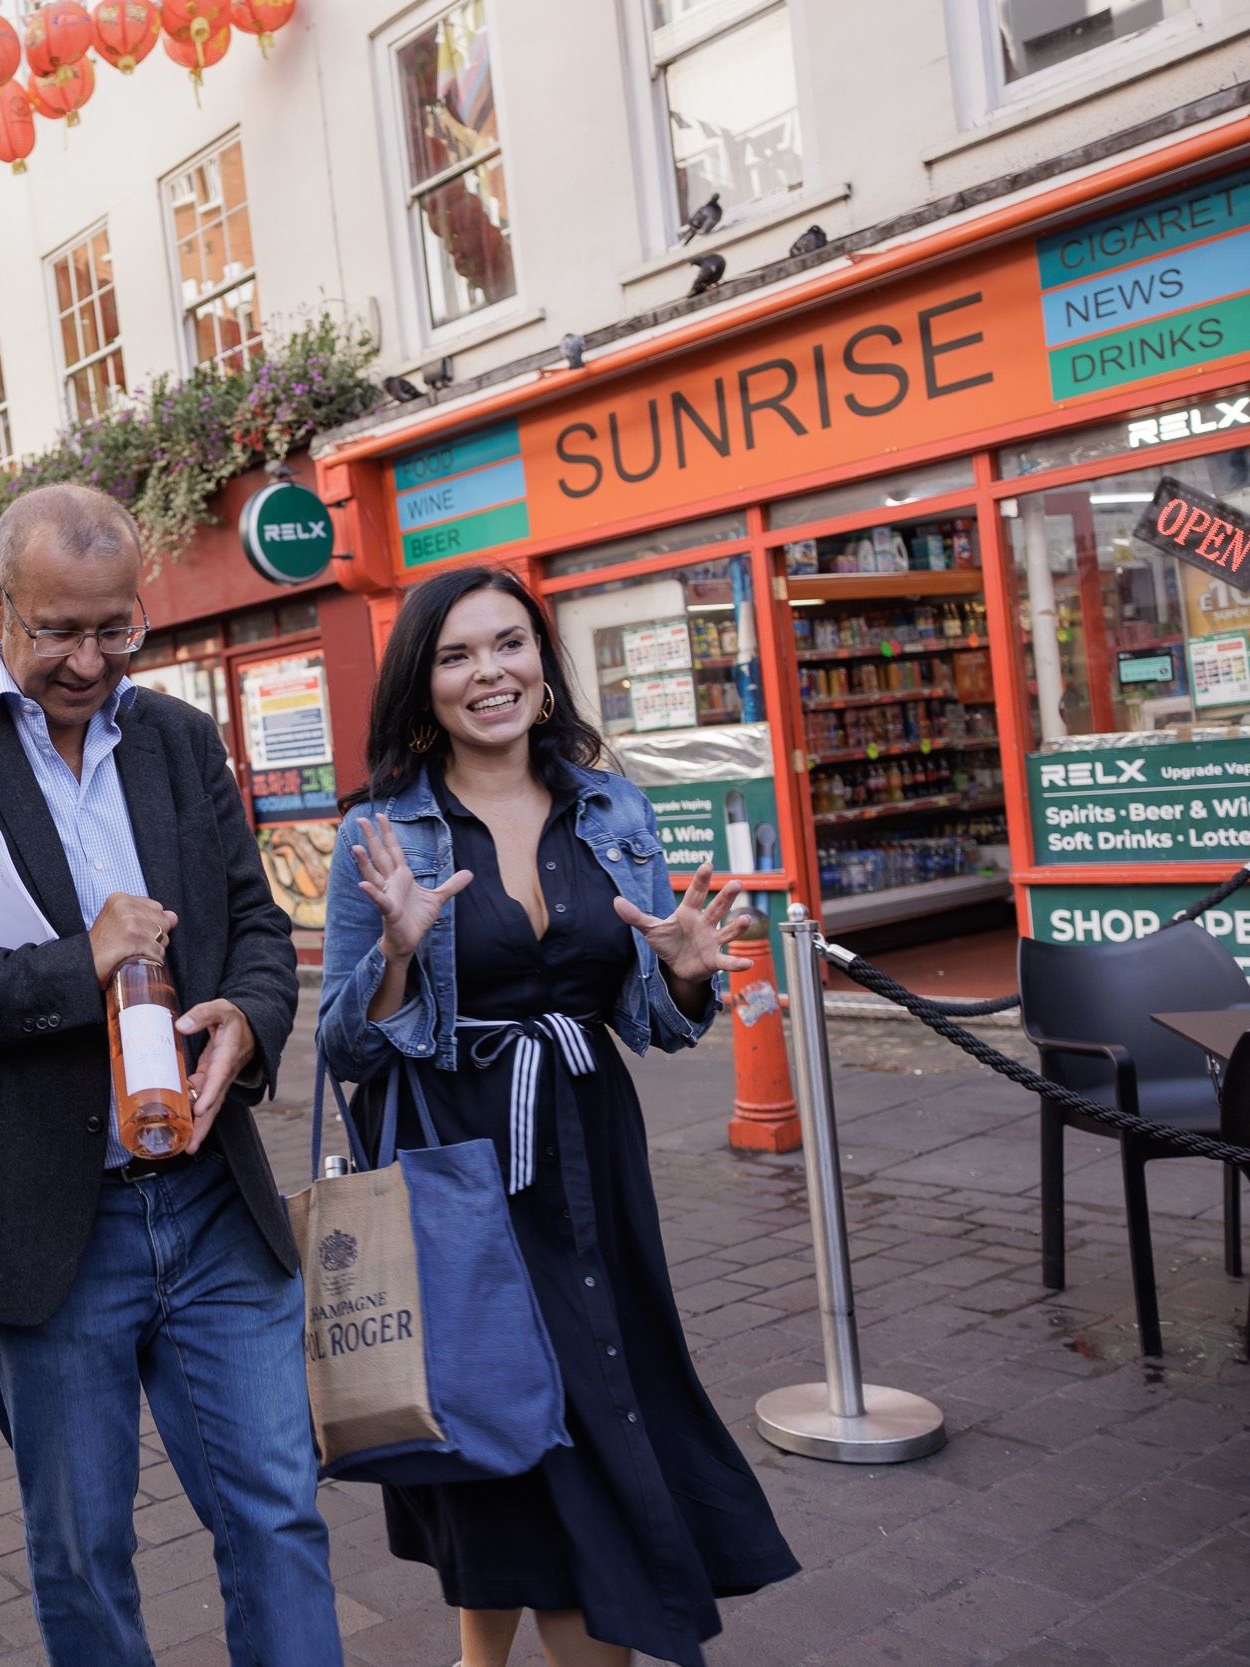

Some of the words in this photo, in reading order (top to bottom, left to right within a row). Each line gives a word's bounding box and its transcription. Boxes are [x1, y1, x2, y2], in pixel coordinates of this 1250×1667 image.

[1065, 268, 1184, 328] NEWS
[1071, 318, 1224, 383] DRINKS
[556, 292, 994, 498] SUNRISE
[1128, 397, 1250, 447] RELX
[403, 451, 455, 480] FOOD
[408, 490, 455, 519] WINE
[263, 521, 327, 542] RELX
[410, 529, 461, 559] BEER
[1157, 498, 1250, 572] OPEN
[1040, 758, 1148, 788] RELX
[1161, 763, 1222, 780] Upgrade
[1045, 803, 1116, 828] Spirits
[1128, 803, 1184, 822] Beer
[1189, 799, 1208, 819] &
[1211, 796, 1250, 818] Wi
[661, 827, 674, 843] &
[674, 825, 714, 842] Wine
[1048, 831, 1094, 851] Soft
[1097, 829, 1173, 850] Drinks
[663, 847, 714, 865] Lottery
[1050, 909, 1161, 942] SHOP
[328, 1309, 413, 1356] ROGER
